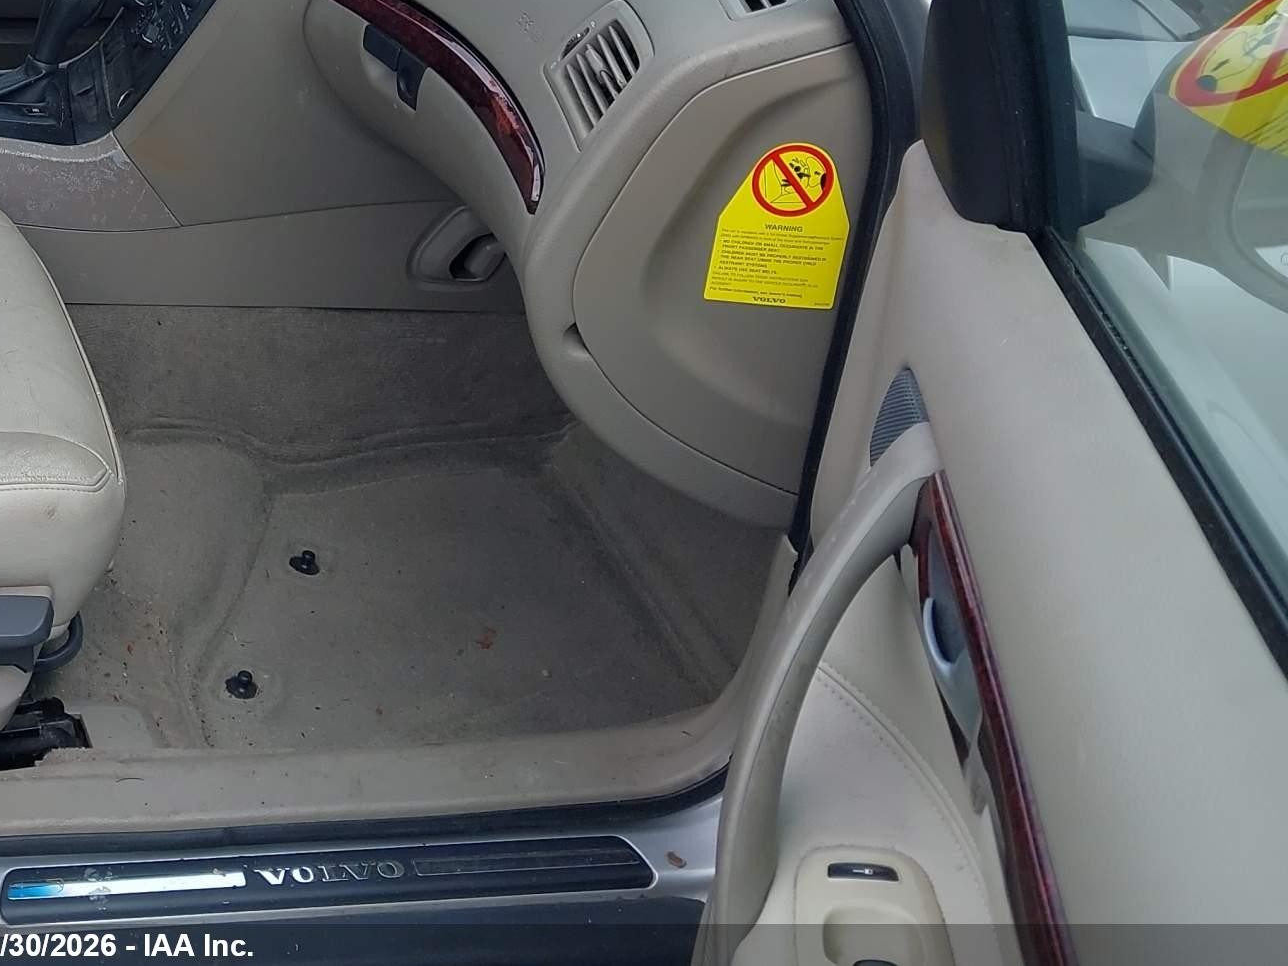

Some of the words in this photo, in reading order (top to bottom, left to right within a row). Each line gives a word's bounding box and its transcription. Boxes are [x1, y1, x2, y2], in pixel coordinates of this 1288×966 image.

[765, 224, 803, 233] WARNING
[753, 296, 786, 304] VOLVO
[253, 861, 405, 885] VOLVO
